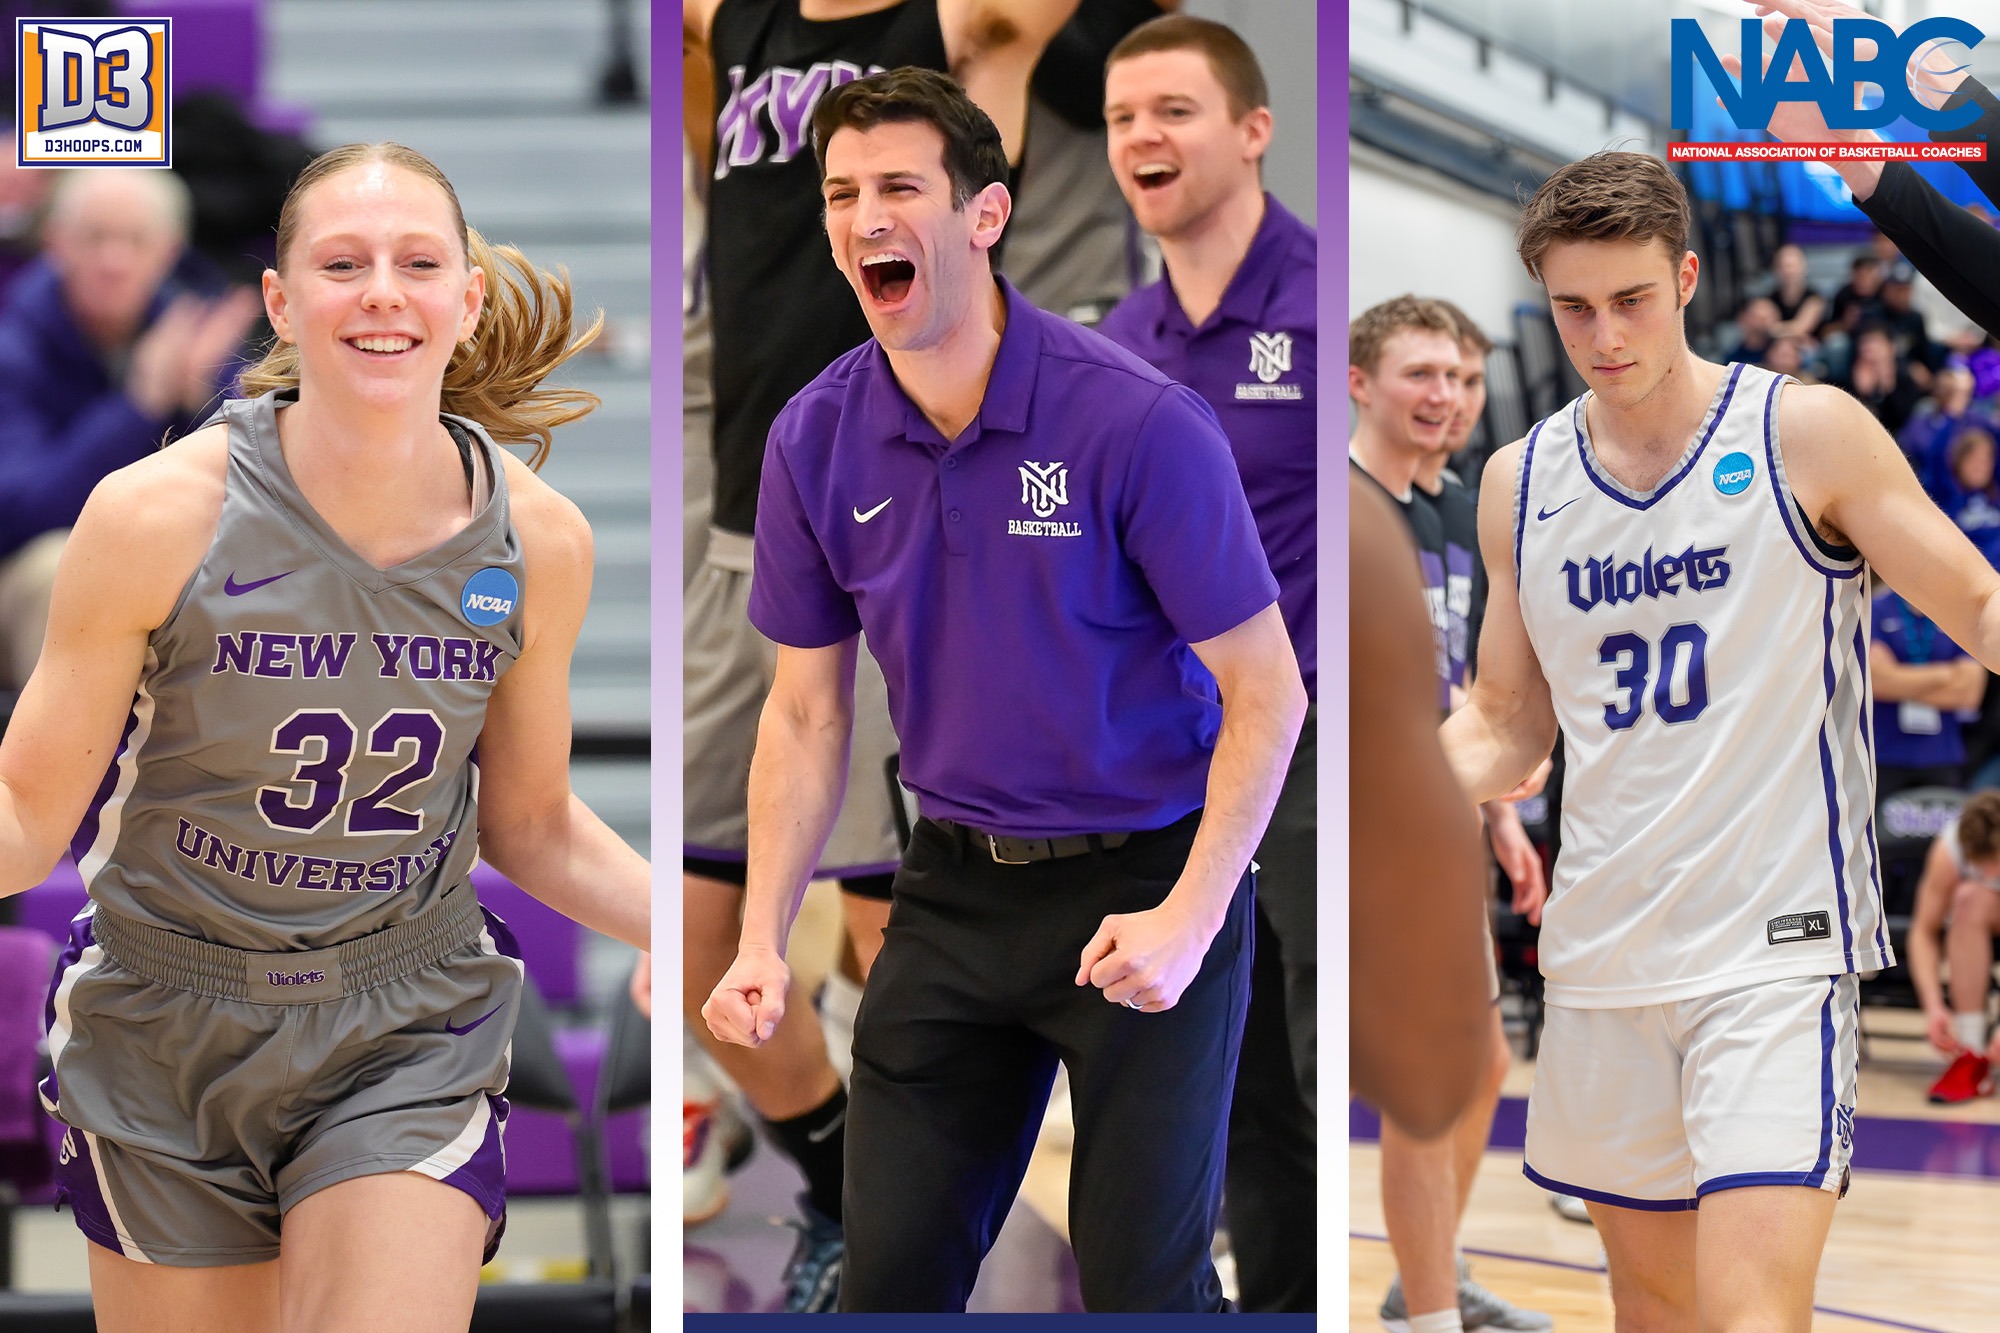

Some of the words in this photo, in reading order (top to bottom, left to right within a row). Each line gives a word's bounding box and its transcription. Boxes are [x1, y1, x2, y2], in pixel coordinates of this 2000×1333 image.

[1719, 468, 1752, 485] NCAA
[1007, 519, 1082, 537] BASKETBALL
[1558, 540, 1734, 615] Violets
[465, 593, 513, 615] NCAA
[211, 631, 358, 679] NEW
[371, 632, 504, 682] YORK
[1596, 620, 1712, 734] 30
[255, 707, 447, 837] 32
[1807, 919, 1825, 932] XL
[266, 969, 326, 988] Violets
